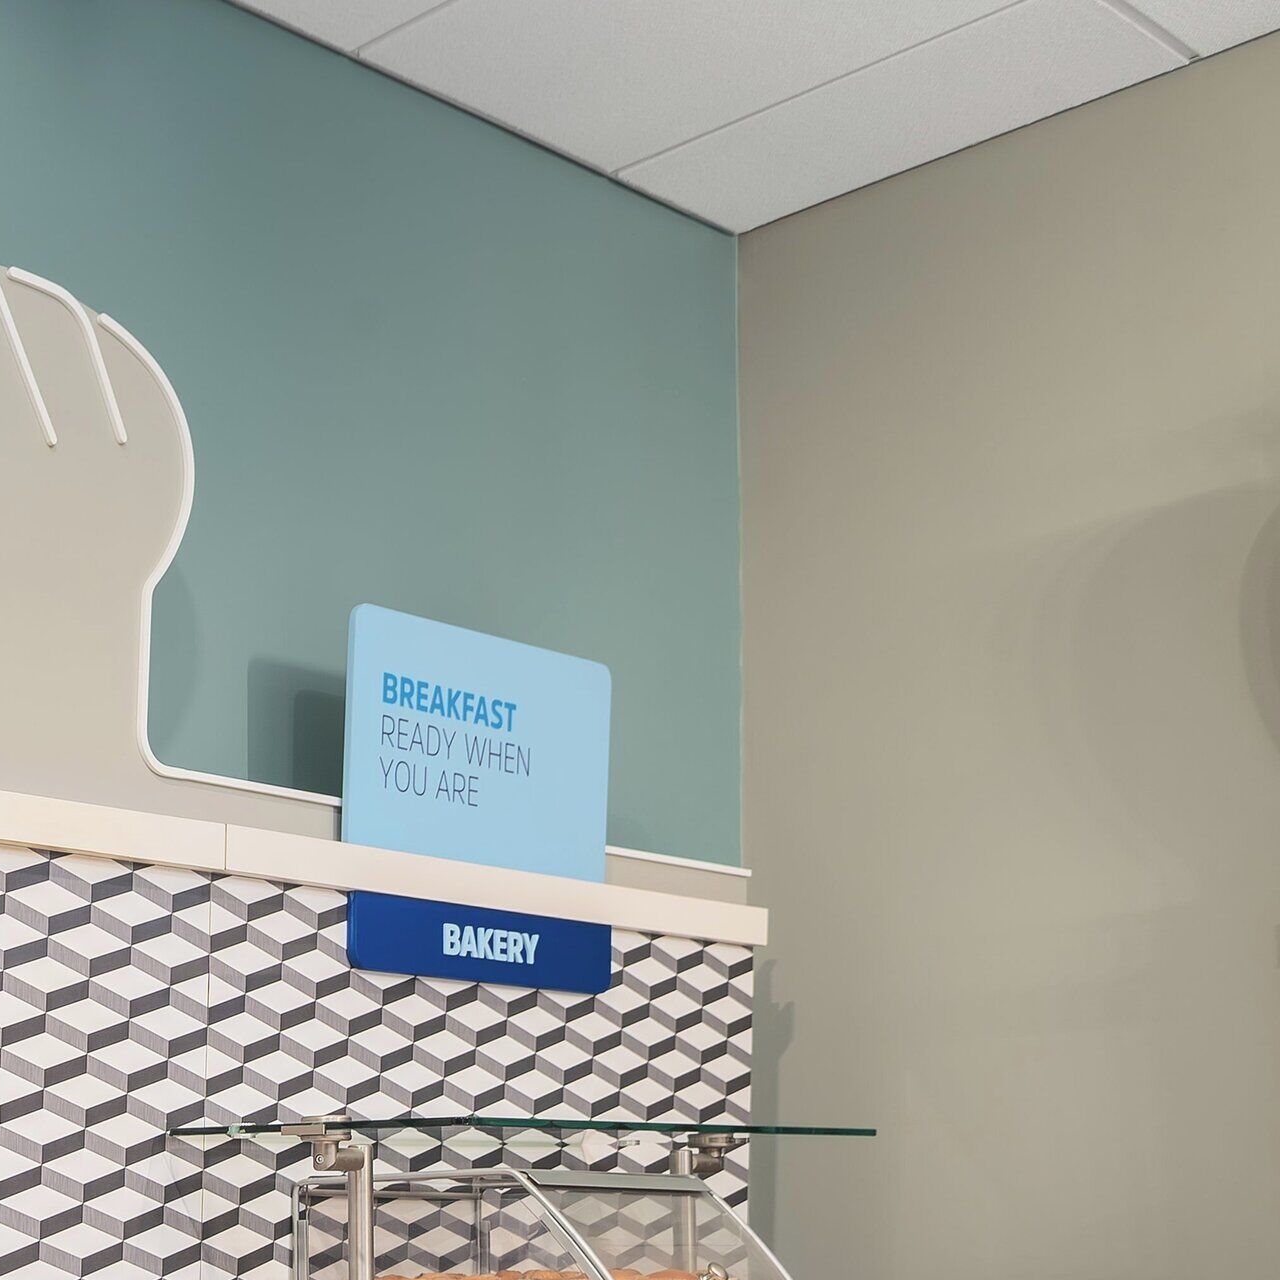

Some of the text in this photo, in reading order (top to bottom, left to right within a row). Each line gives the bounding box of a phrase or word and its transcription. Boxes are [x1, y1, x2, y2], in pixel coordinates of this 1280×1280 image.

[382, 671, 517, 733] BREAKFAST
[380, 714, 531, 777] READY WHEN
[379, 755, 479, 807] YOU ARE
[442, 922, 539, 965] BAKERY
